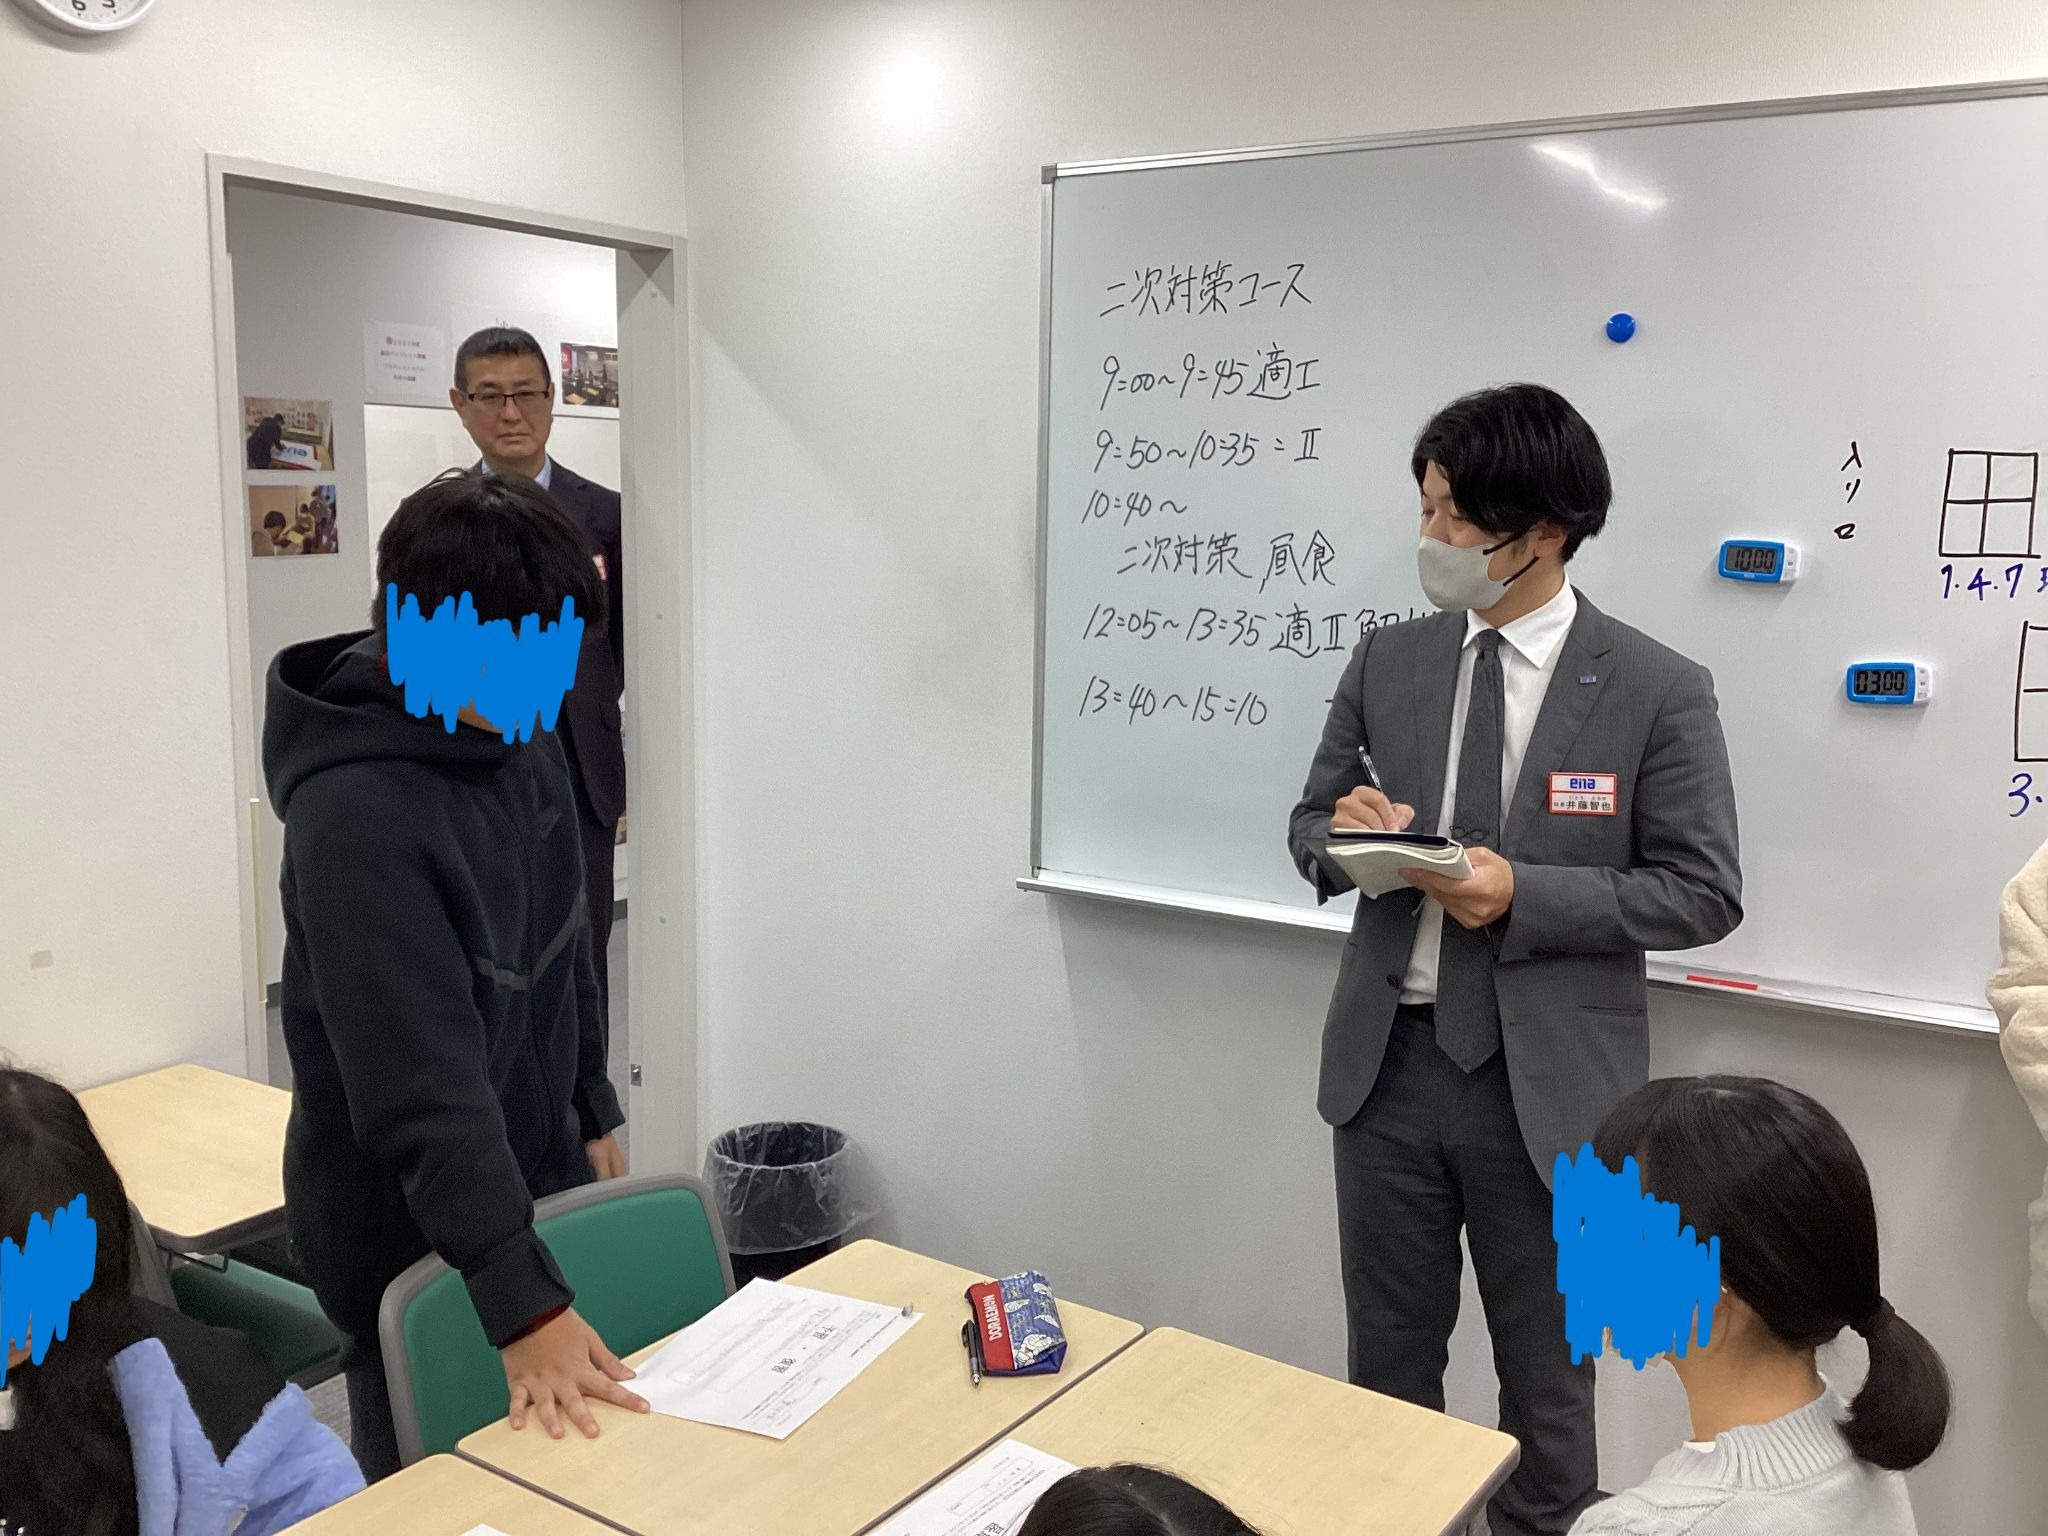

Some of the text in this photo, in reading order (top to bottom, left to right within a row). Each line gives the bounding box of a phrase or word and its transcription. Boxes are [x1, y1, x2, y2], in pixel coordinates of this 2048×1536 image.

[1100, 260, 1312, 316] 二次対策コース
[1570, 778, 1596, 790] ena
